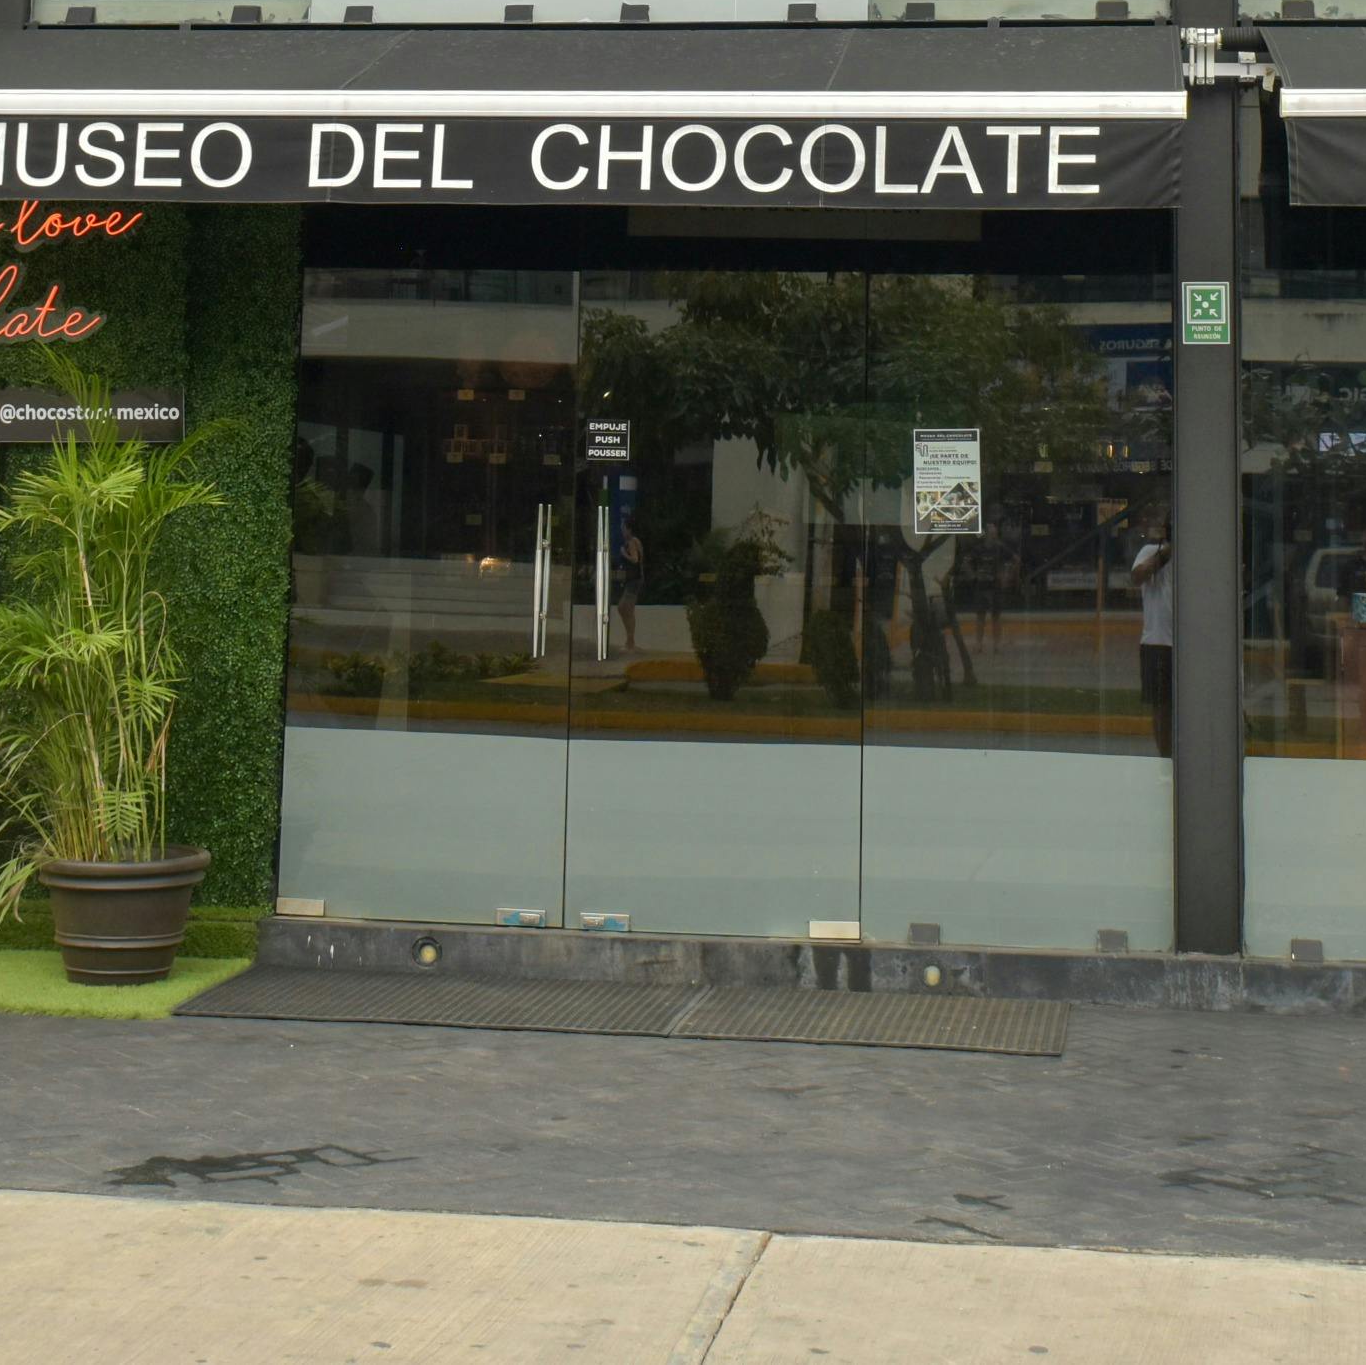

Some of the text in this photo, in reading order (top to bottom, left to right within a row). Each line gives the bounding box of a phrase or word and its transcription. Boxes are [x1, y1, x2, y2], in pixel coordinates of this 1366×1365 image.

[307, 122, 474, 190] DEL
[530, 123, 1101, 195] CHOCOLATE
[9, 199, 144, 248] love
[589, 422, 627, 431] EMPUJE
[595, 435, 620, 444] PUSH
[588, 449, 627, 457] POUSSER
